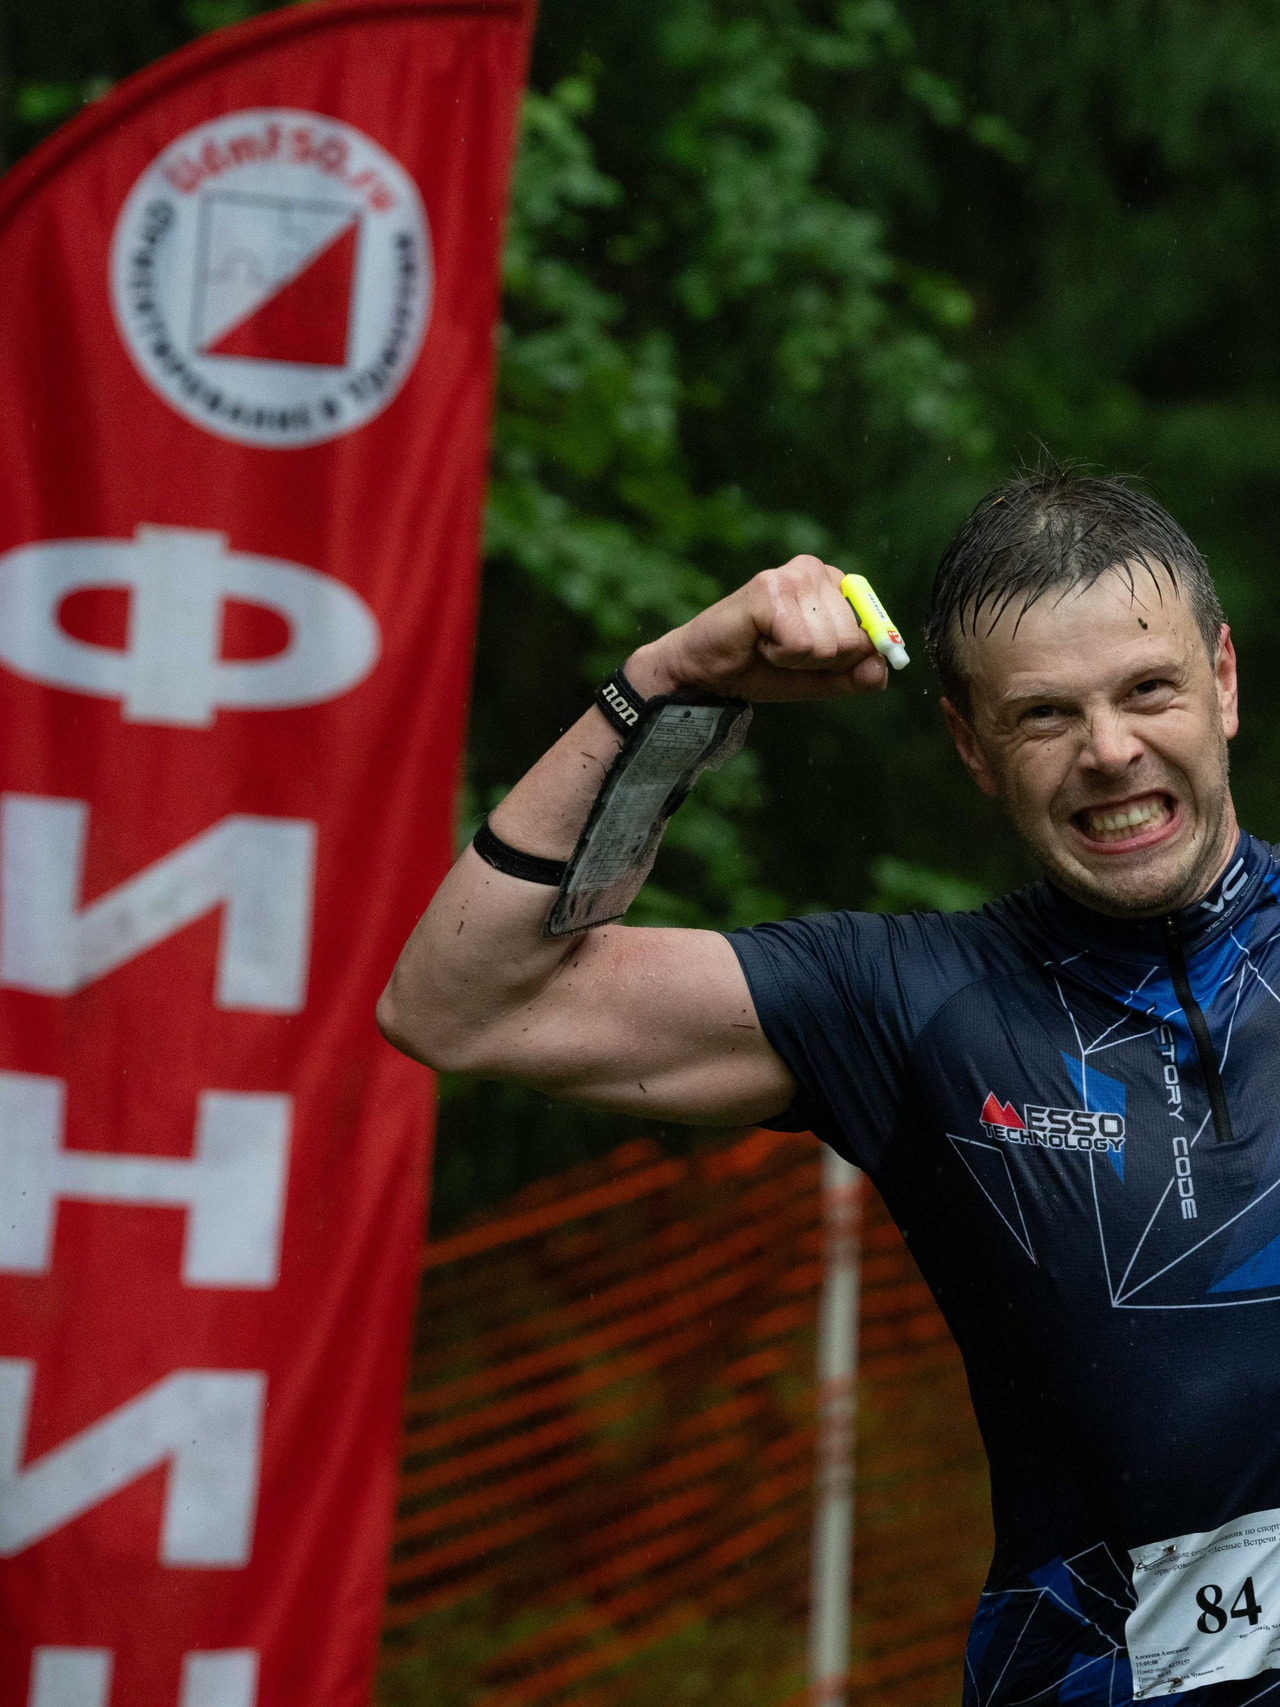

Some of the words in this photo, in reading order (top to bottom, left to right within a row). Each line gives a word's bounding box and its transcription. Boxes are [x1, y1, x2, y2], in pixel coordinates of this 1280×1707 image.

[1200, 857, 1249, 913] VC
[1204, 901, 1240, 932] VICTORY
[982, 1121, 1126, 1153] TECHNOLOGY
[1172, 1136, 1198, 1220] CODE
[1243, 1535, 1277, 1548] Встречи
[1245, 1527, 1256, 1536] по
[1195, 1576, 1263, 1635] 84
